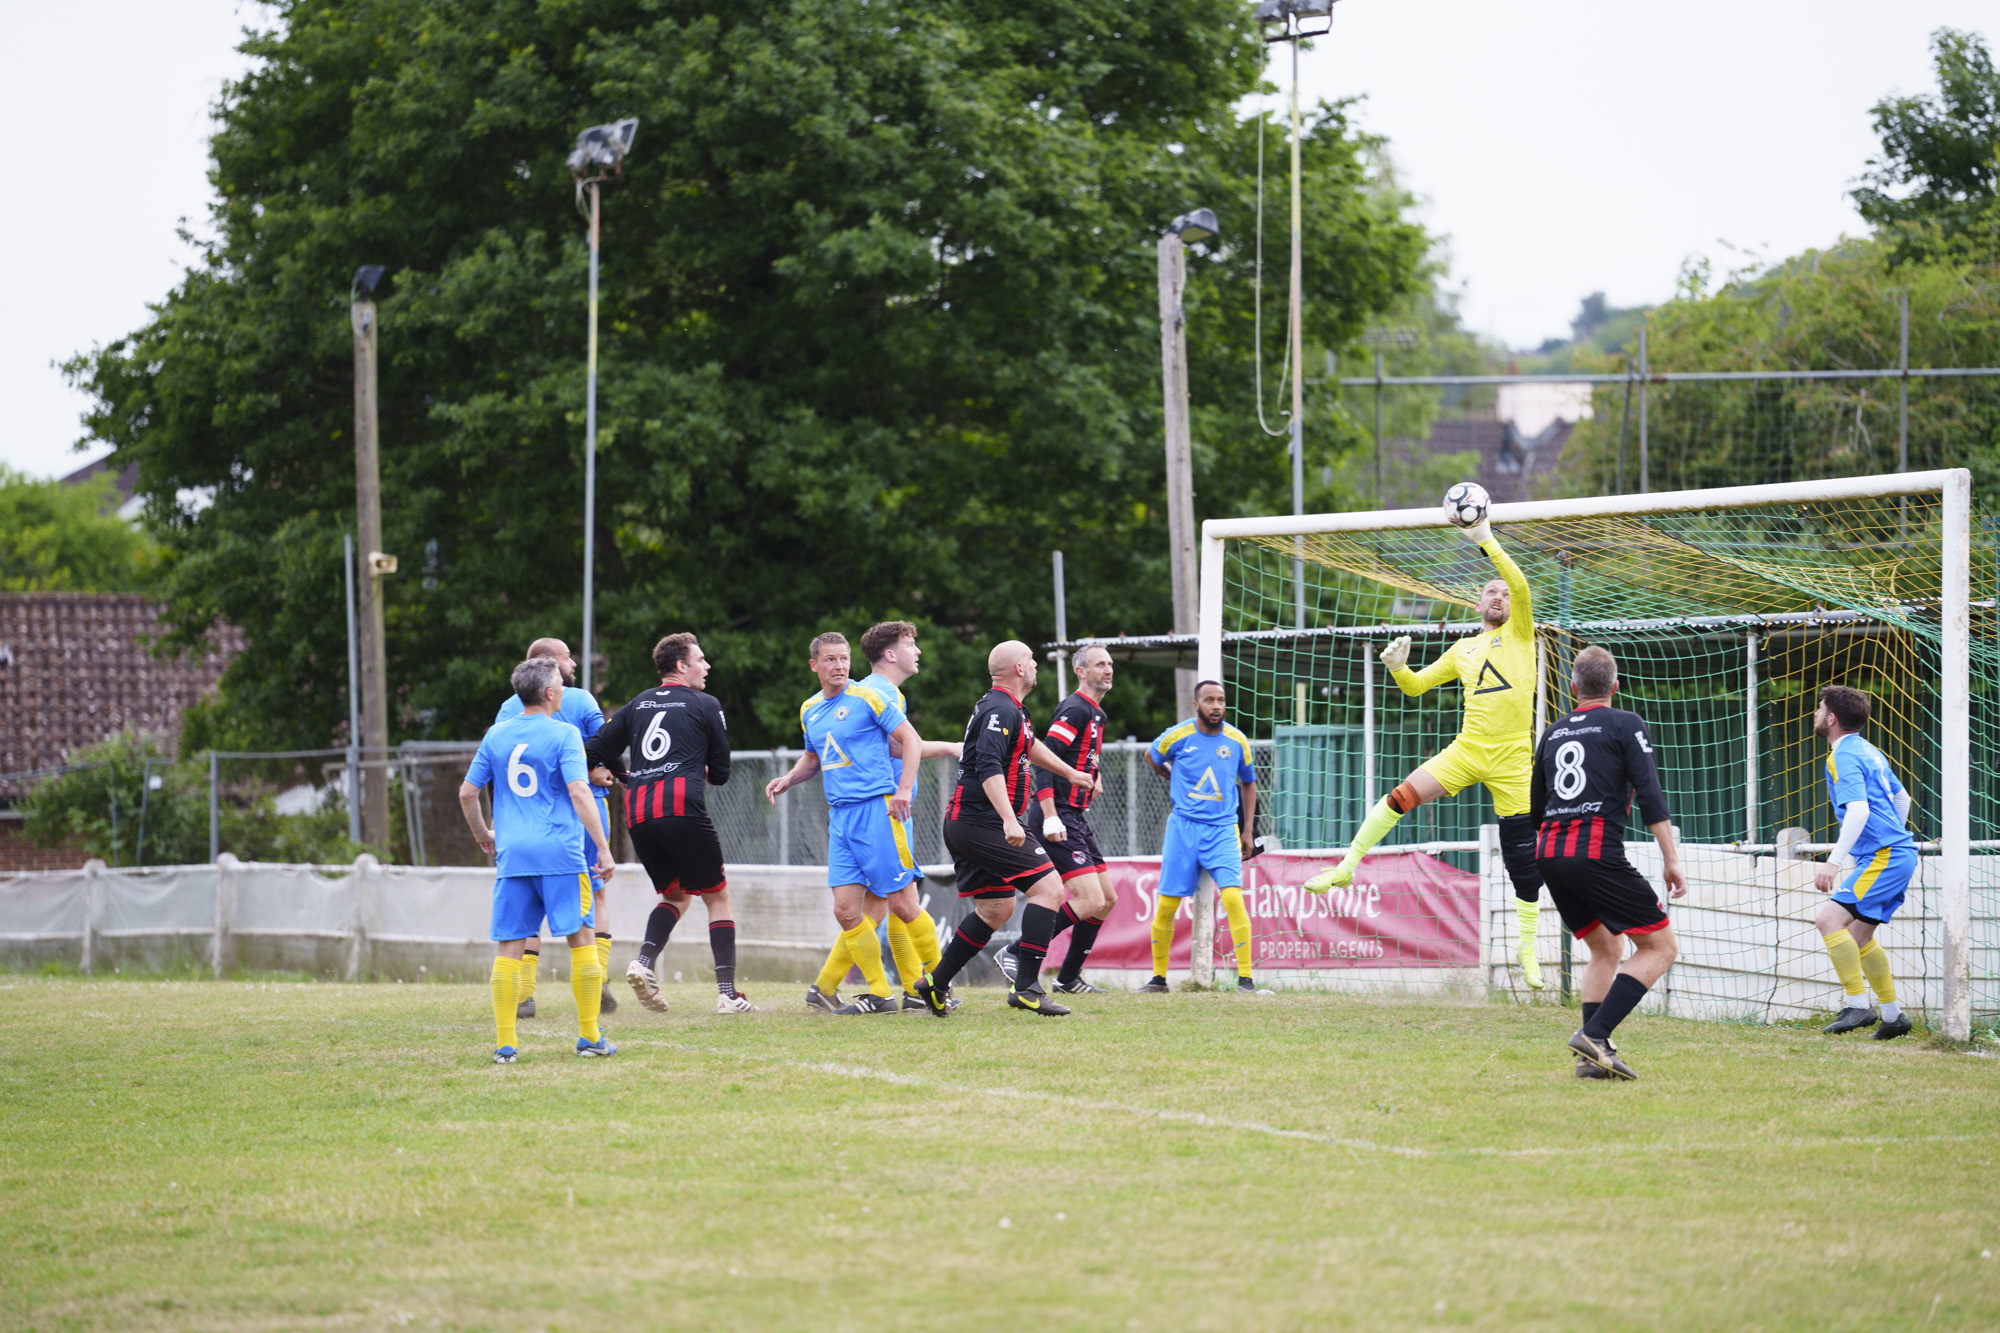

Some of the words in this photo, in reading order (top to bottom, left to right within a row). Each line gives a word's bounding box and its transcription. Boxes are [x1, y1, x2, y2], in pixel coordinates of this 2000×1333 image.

[641, 711, 671, 761] 6
[1090, 722, 1098, 739] 5
[507, 743, 538, 797] 6
[1554, 741, 1587, 800] 8
[1260, 940, 1322, 959] PROPERTY
[1329, 940, 1384, 959] AGENTS
